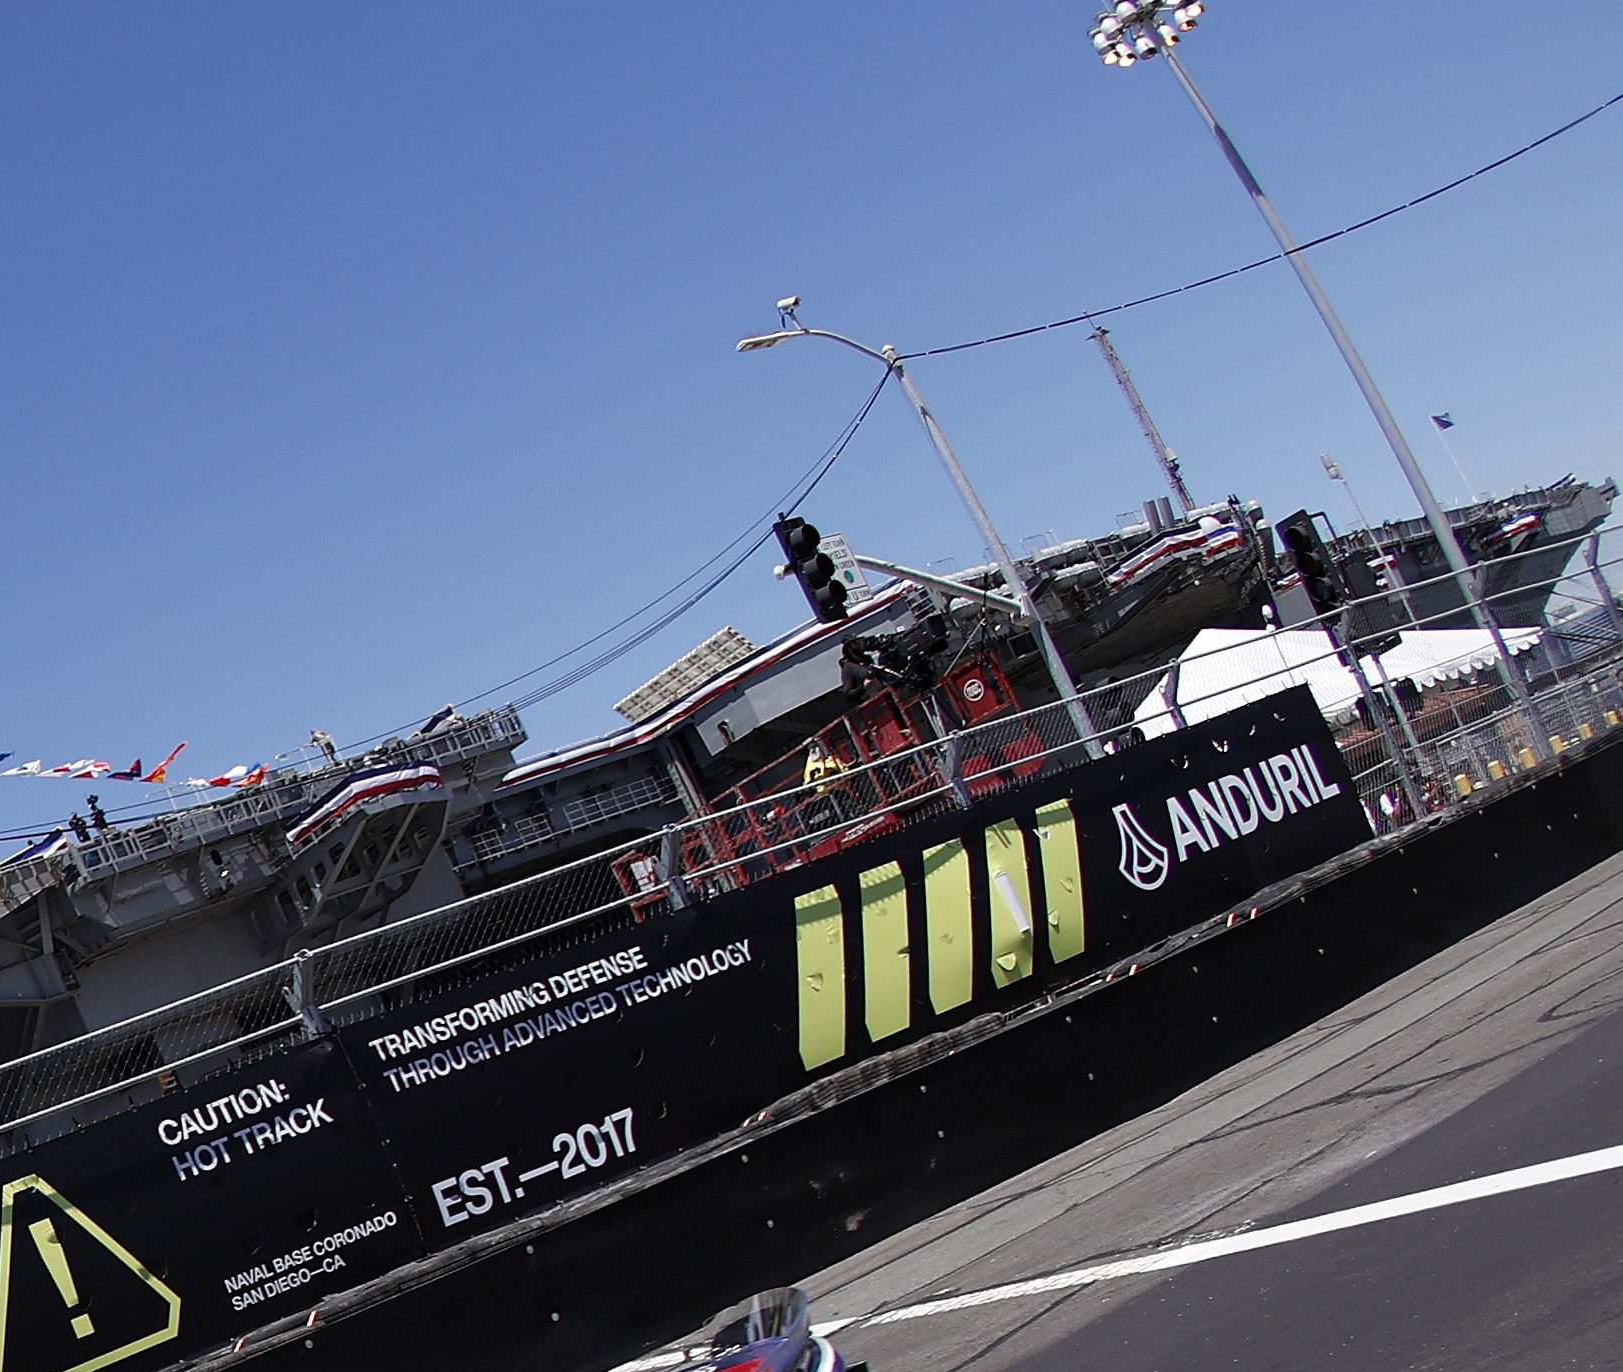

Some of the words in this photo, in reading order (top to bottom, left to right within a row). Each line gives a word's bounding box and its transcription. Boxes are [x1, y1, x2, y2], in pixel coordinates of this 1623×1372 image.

[1167, 744, 1342, 861] ANDURIL
[368, 982, 553, 1062] TRANSFORMING
[547, 946, 648, 999] DEFENSE
[383, 1033, 502, 1093] THROUGH
[503, 991, 618, 1056] ADVANCED
[615, 939, 753, 1009] TECHNOLOGY
[158, 1079, 290, 1146] CAUTION:
[171, 1136, 232, 1181] HOT
[233, 1098, 334, 1155] TRACK
[224, 1261, 275, 1294] NAVAL
[271, 1246, 315, 1276] BASE
[313, 1211, 398, 1258] CORONADO
[231, 1289, 266, 1312] SAN
